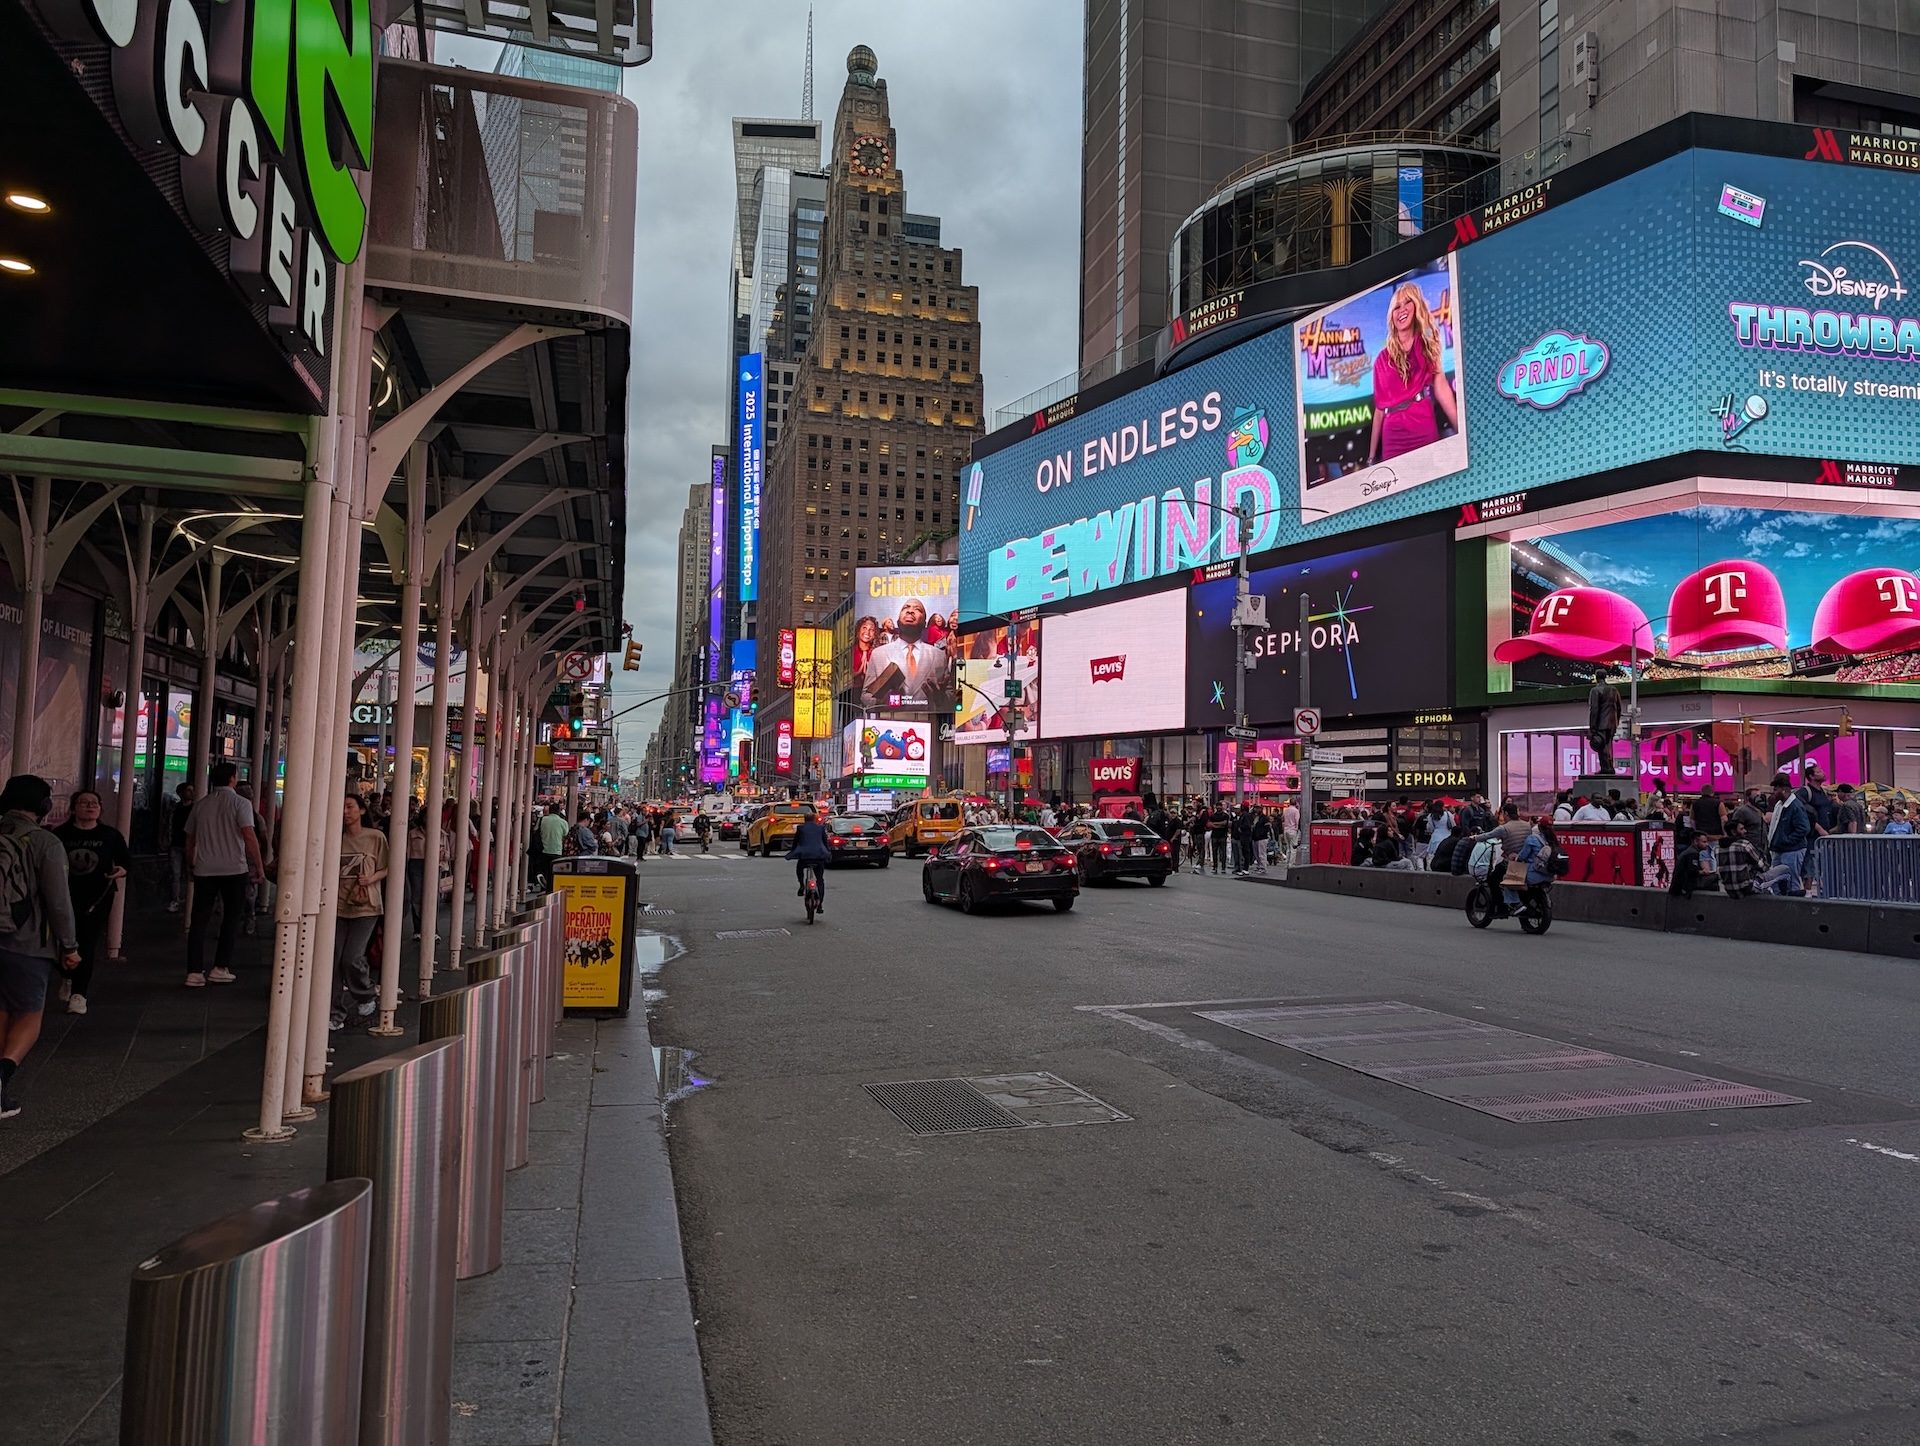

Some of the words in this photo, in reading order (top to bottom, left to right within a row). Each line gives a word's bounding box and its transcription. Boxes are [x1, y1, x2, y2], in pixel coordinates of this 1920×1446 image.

[1850, 134, 1920, 153] MARRIOT
[1850, 151, 1920, 168] MARQUIS
[1484, 179, 1552, 217] MARRIOTT
[1484, 197, 1545, 231] MARQUIS
[1189, 291, 1244, 321] MARRIOTT
[1189, 307, 1237, 333] MARQUIS
[1541, 341, 1560, 356] The
[1514, 349, 1589, 389] PRNDL
[1759, 369, 1786, 389] It's
[1792, 373, 1848, 397] totally
[745, 391, 755, 420] 2025
[1047, 396, 1078, 416] MARRIOTT
[1047, 407, 1074, 424] MARQUIS
[1310, 405, 1372, 431] MONTANA
[1037, 451, 1072, 493] ON
[1083, 391, 1222, 477] ENDLESS
[743, 423, 754, 504] International
[1846, 464, 1900, 476] MARRIOTT
[1846, 475, 1894, 486] MARQUIS
[1482, 493, 1527, 510] MARRIOTT
[1482, 504, 1521, 519] MARQUIS
[742, 506, 754, 552] Airport
[743, 556, 754, 586] Expo
[1206, 560, 1235, 572] MARRIOTT
[1206, 569, 1231, 580] MARQUIS
[42, 618, 54, 634] OF
[54, 622, 60, 637] A
[61, 624, 92, 648] LIFETIME
[1679, 703, 1701, 712] 1535
[1414, 713, 1453, 724] SEPHORA
[1244, 729, 1256, 737] WAY
[1396, 772, 1467, 786] SEPHORA
[1569, 836, 1588, 845] THE.
[1589, 836, 1629, 847] CHARTS.
[1641, 831, 1656, 840] BEAT
[1642, 840, 1656, 852] IT
[1661, 848, 1674, 860] BAD
